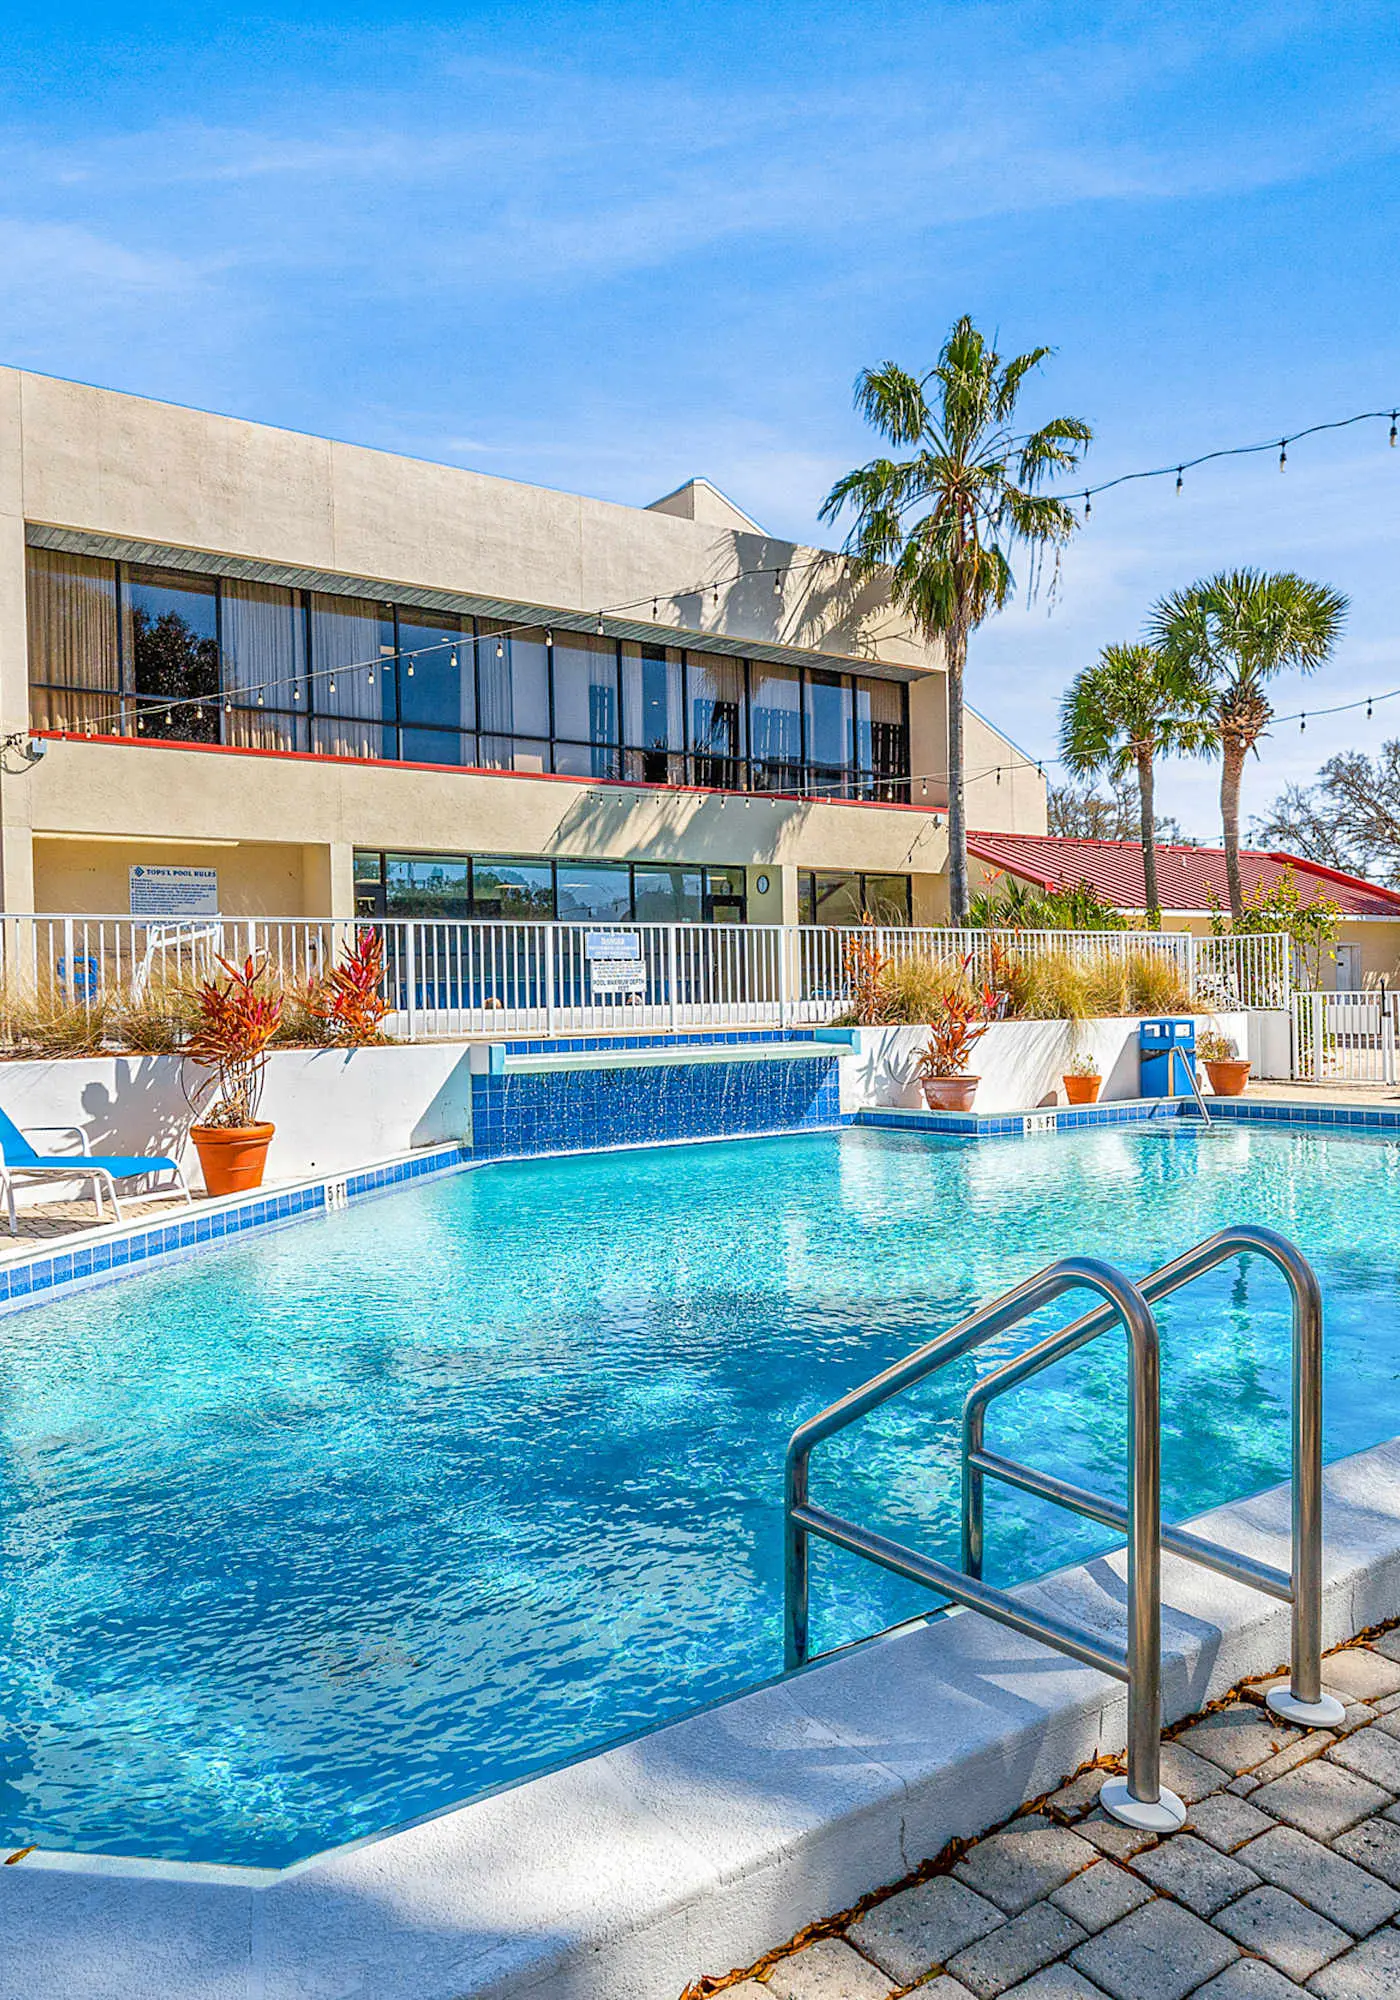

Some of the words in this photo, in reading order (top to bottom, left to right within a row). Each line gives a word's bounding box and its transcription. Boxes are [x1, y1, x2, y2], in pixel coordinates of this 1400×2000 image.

[194, 870, 216, 878] RULES
[1046, 1116, 1055, 1127] FT
[328, 1186, 334, 1202] 5
[336, 1183, 345, 1200] FT
